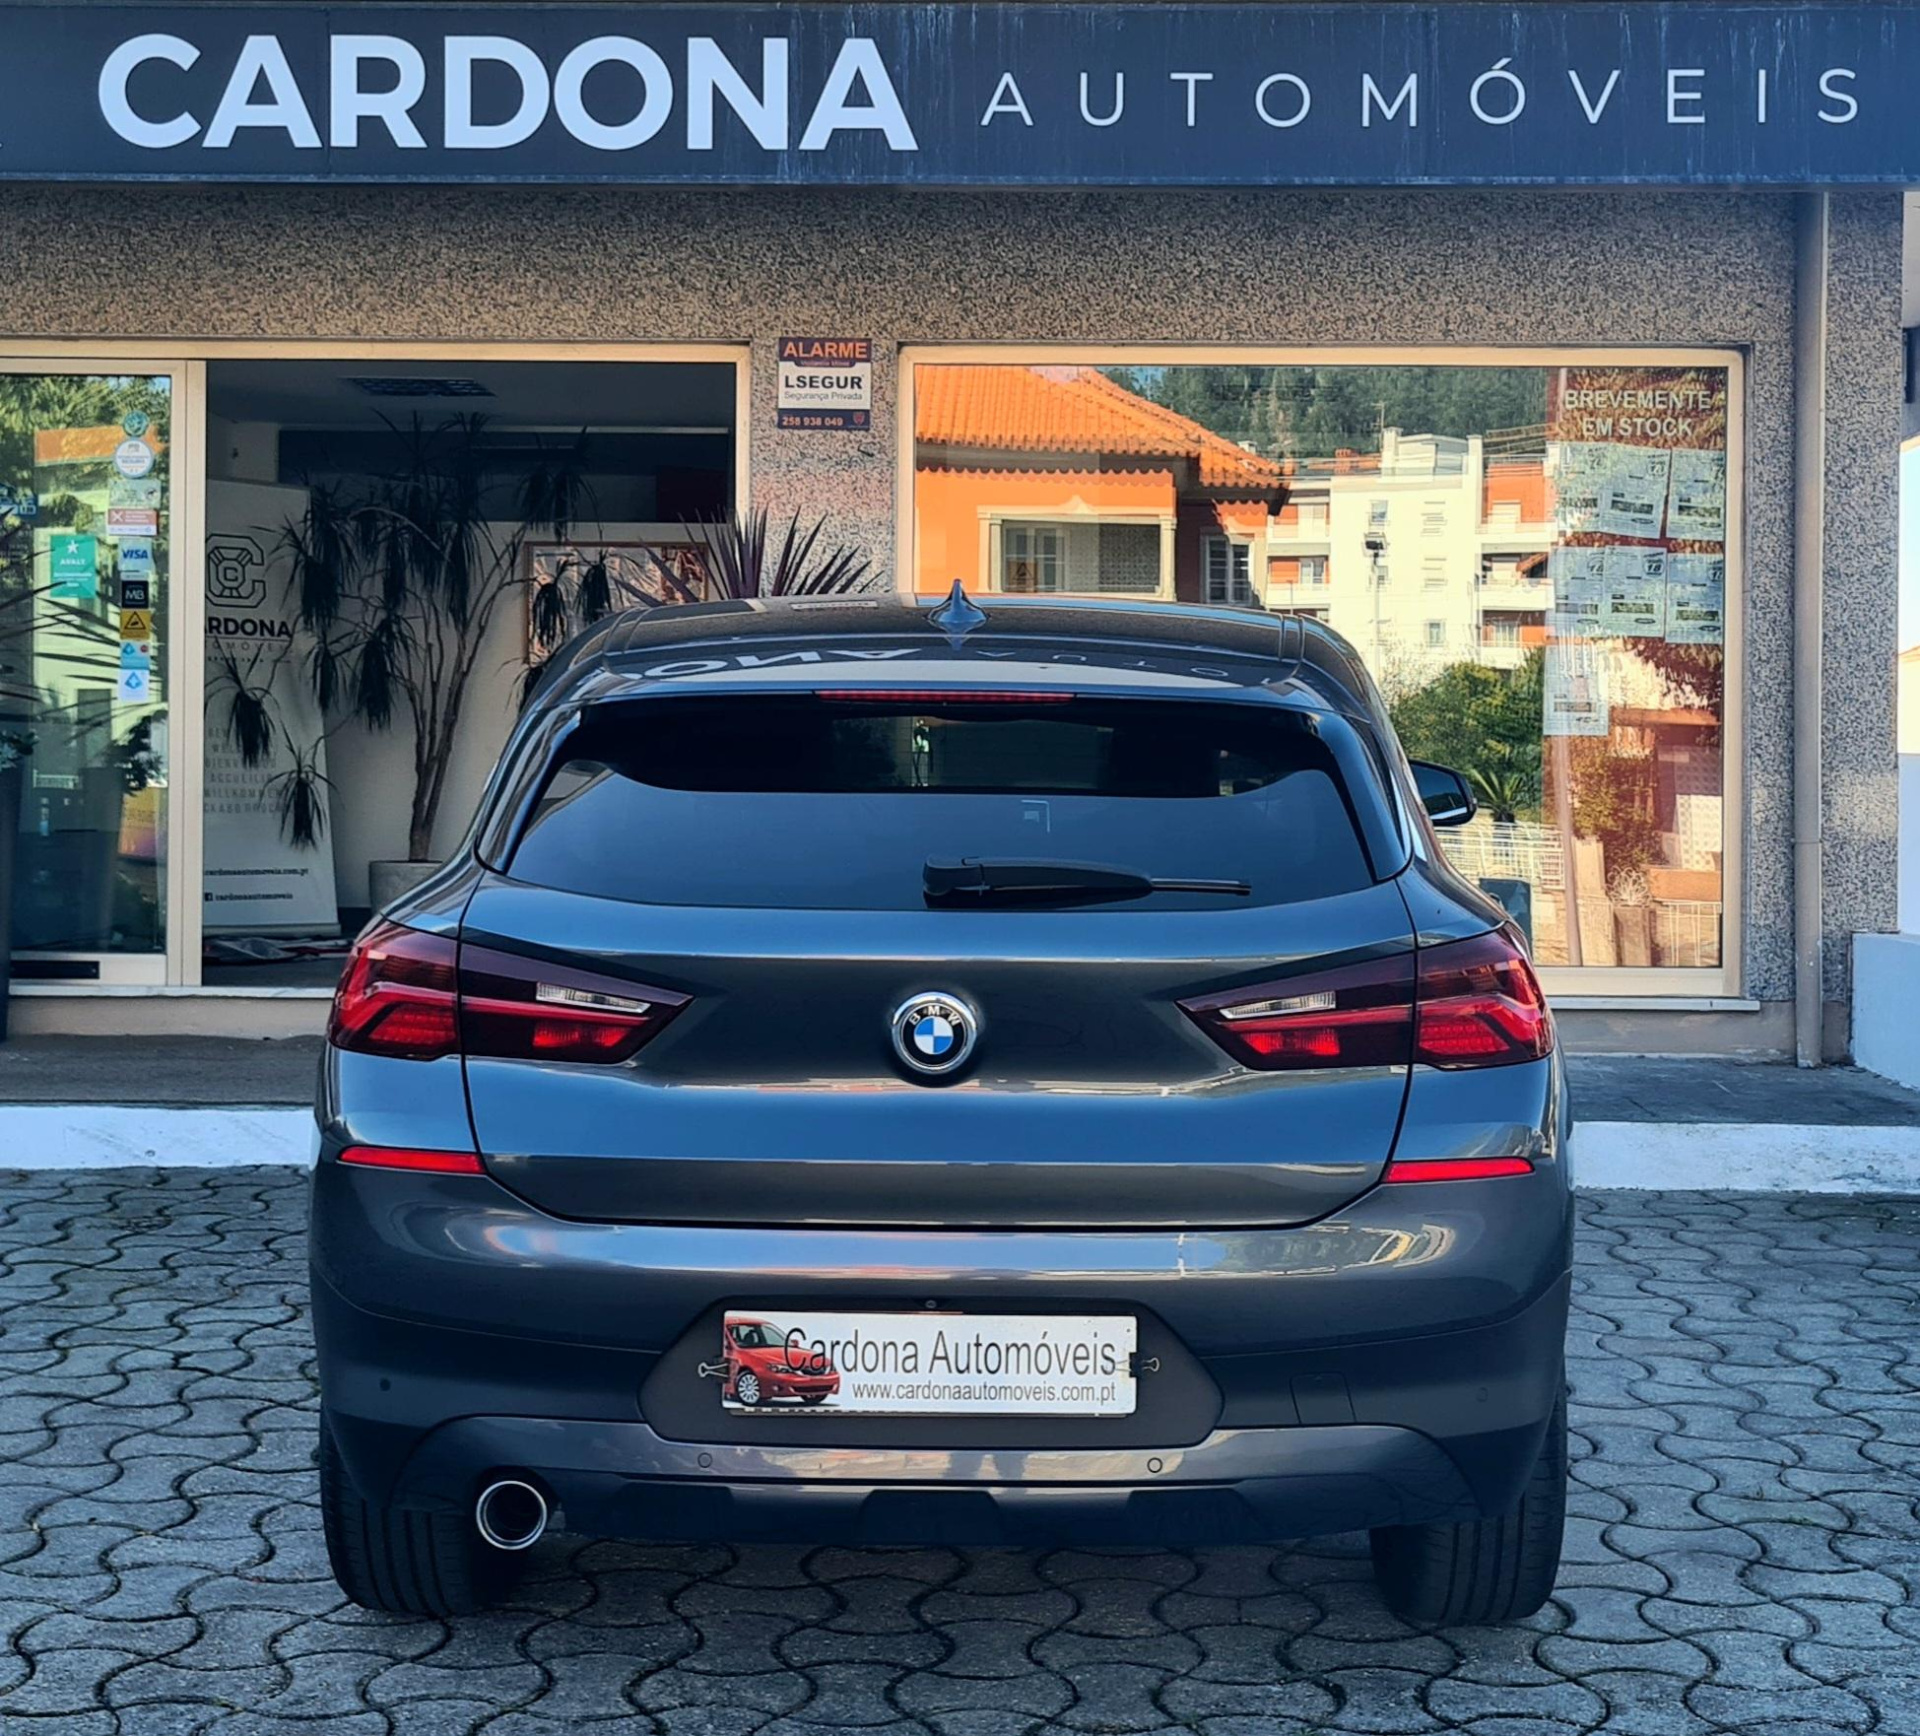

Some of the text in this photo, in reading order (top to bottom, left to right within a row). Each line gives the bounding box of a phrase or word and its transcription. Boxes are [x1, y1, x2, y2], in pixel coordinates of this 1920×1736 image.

[98, 33, 1859, 151] CARDONA AUTOMÓVEIS
[783, 341, 868, 359] ALARME
[784, 375, 863, 390] LSEGUR
[784, 392, 863, 401] Segurança Privada
[1564, 390, 1712, 410] BREVEMENTE
[1583, 418, 1693, 437] EM STOCK
[122, 549, 149, 560] VISA
[125, 590, 145, 600] MB
[205, 616, 292, 638] RDONA
[908, 1004, 962, 1027] BMW
[784, 1327, 1117, 1376] Cardona Automóveis
[852, 1380, 1117, 1405] www.cardonaautomoveis.com.pt
